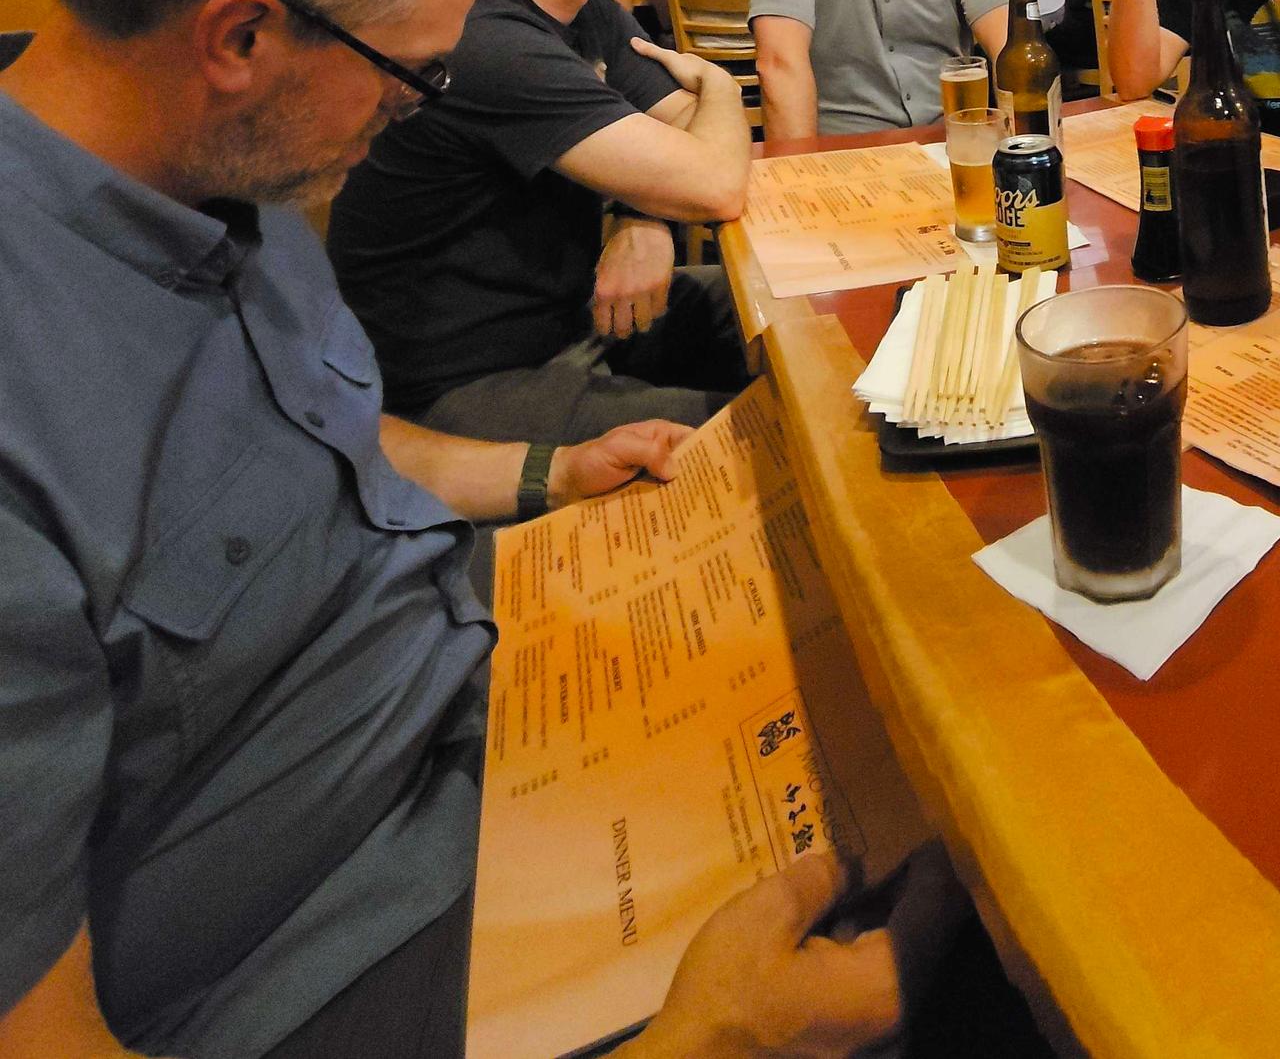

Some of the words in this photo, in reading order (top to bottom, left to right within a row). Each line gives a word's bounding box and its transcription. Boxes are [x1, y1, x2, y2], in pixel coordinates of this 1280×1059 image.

[994, 186, 1040, 209] oors
[748, 578, 765, 618] OCHAZUKE
[559, 673, 569, 725] BEVERAGES
[611, 815, 632, 886] DINNER
[617, 886, 638, 947] MENU
